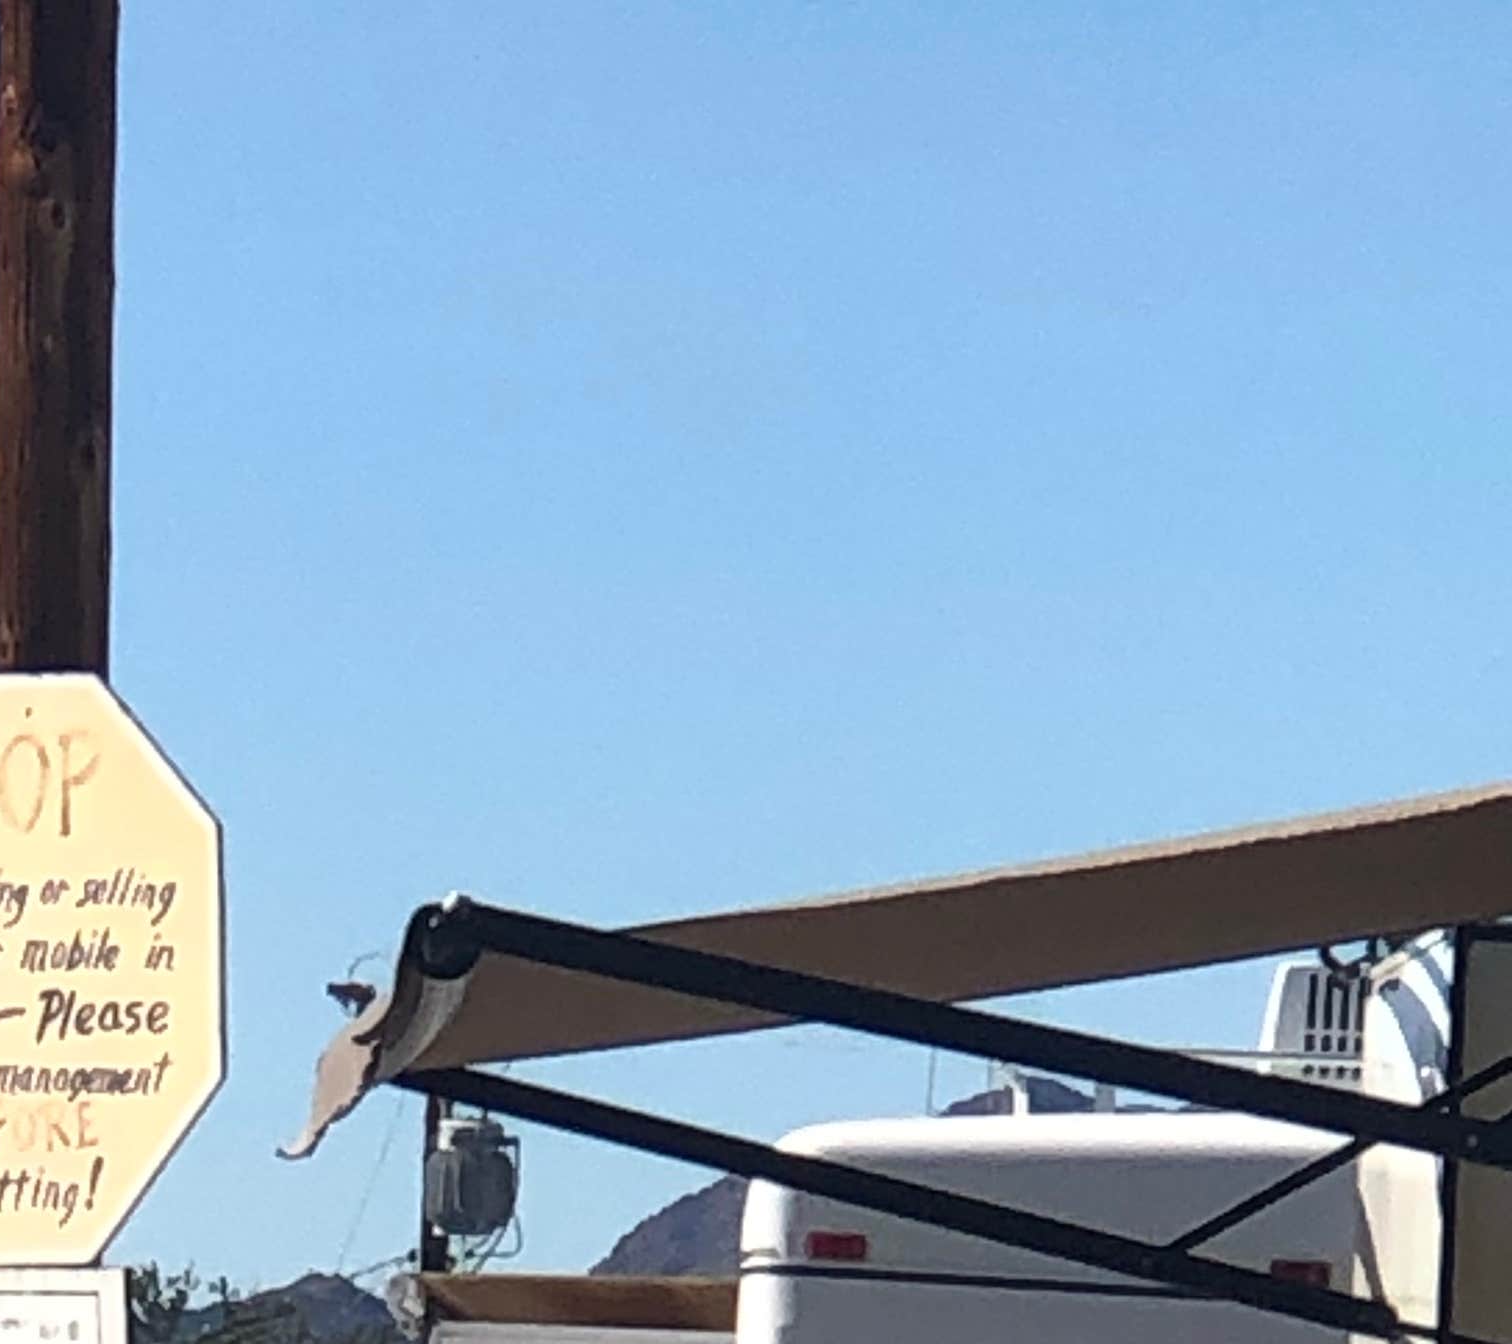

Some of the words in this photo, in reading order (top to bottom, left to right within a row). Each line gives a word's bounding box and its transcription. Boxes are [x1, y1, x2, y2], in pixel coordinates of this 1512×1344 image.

[39, 878, 70, 904] or
[75, 867, 176, 927] selling
[19, 926, 120, 974] mobile
[144, 932, 175, 971] in
[35, 986, 170, 1045] Please
